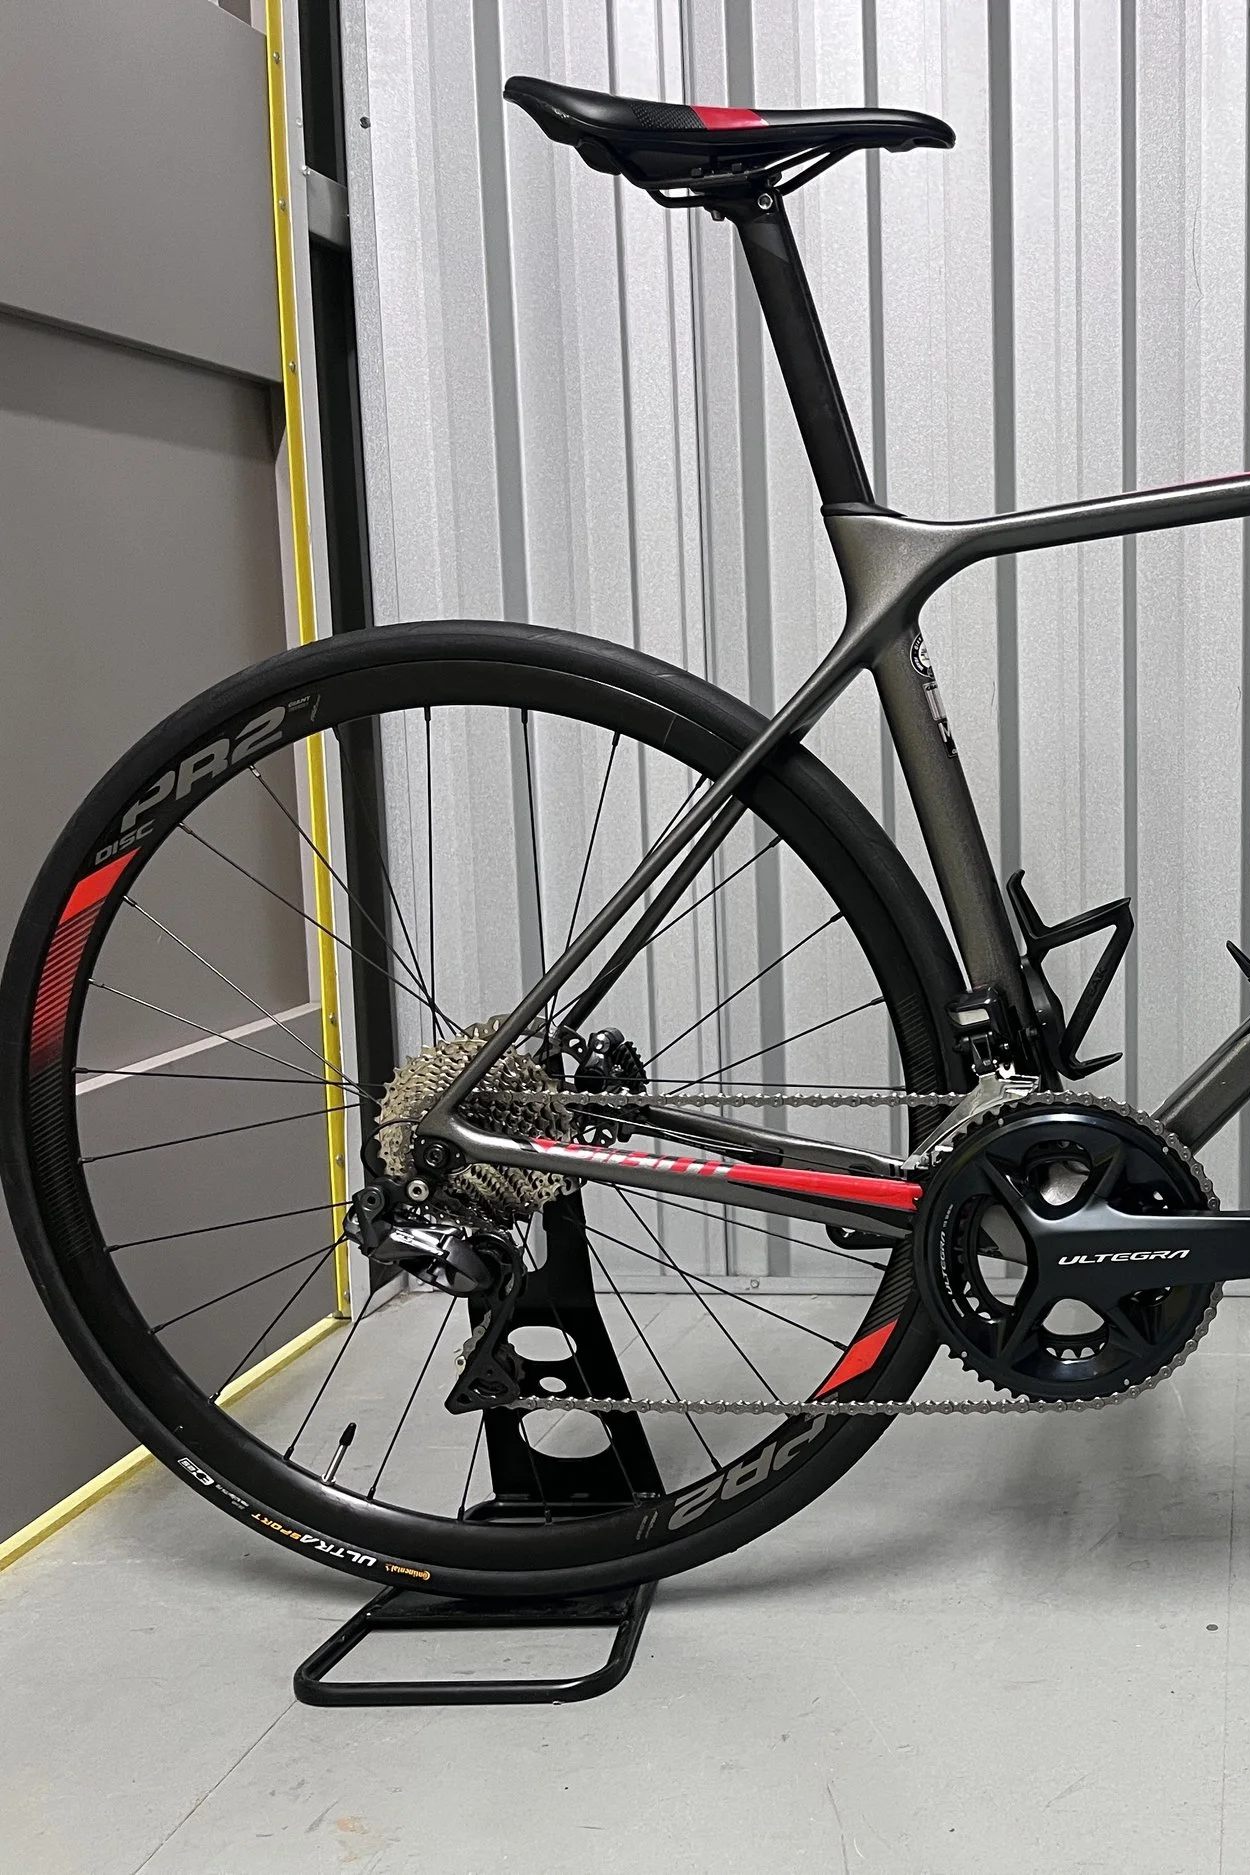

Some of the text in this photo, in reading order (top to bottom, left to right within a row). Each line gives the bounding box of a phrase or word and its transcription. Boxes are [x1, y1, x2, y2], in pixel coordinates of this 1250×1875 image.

[120, 706, 286, 834] PR2
[95, 819, 156, 866] DISC
[940, 1230, 953, 1295] ULTEGRA
[1058, 1248, 1190, 1266] ULTEGRA
[668, 1413, 828, 1530] PR2
[251, 1513, 302, 1541] SPORT
[300, 1533, 377, 1567] ULTRA
